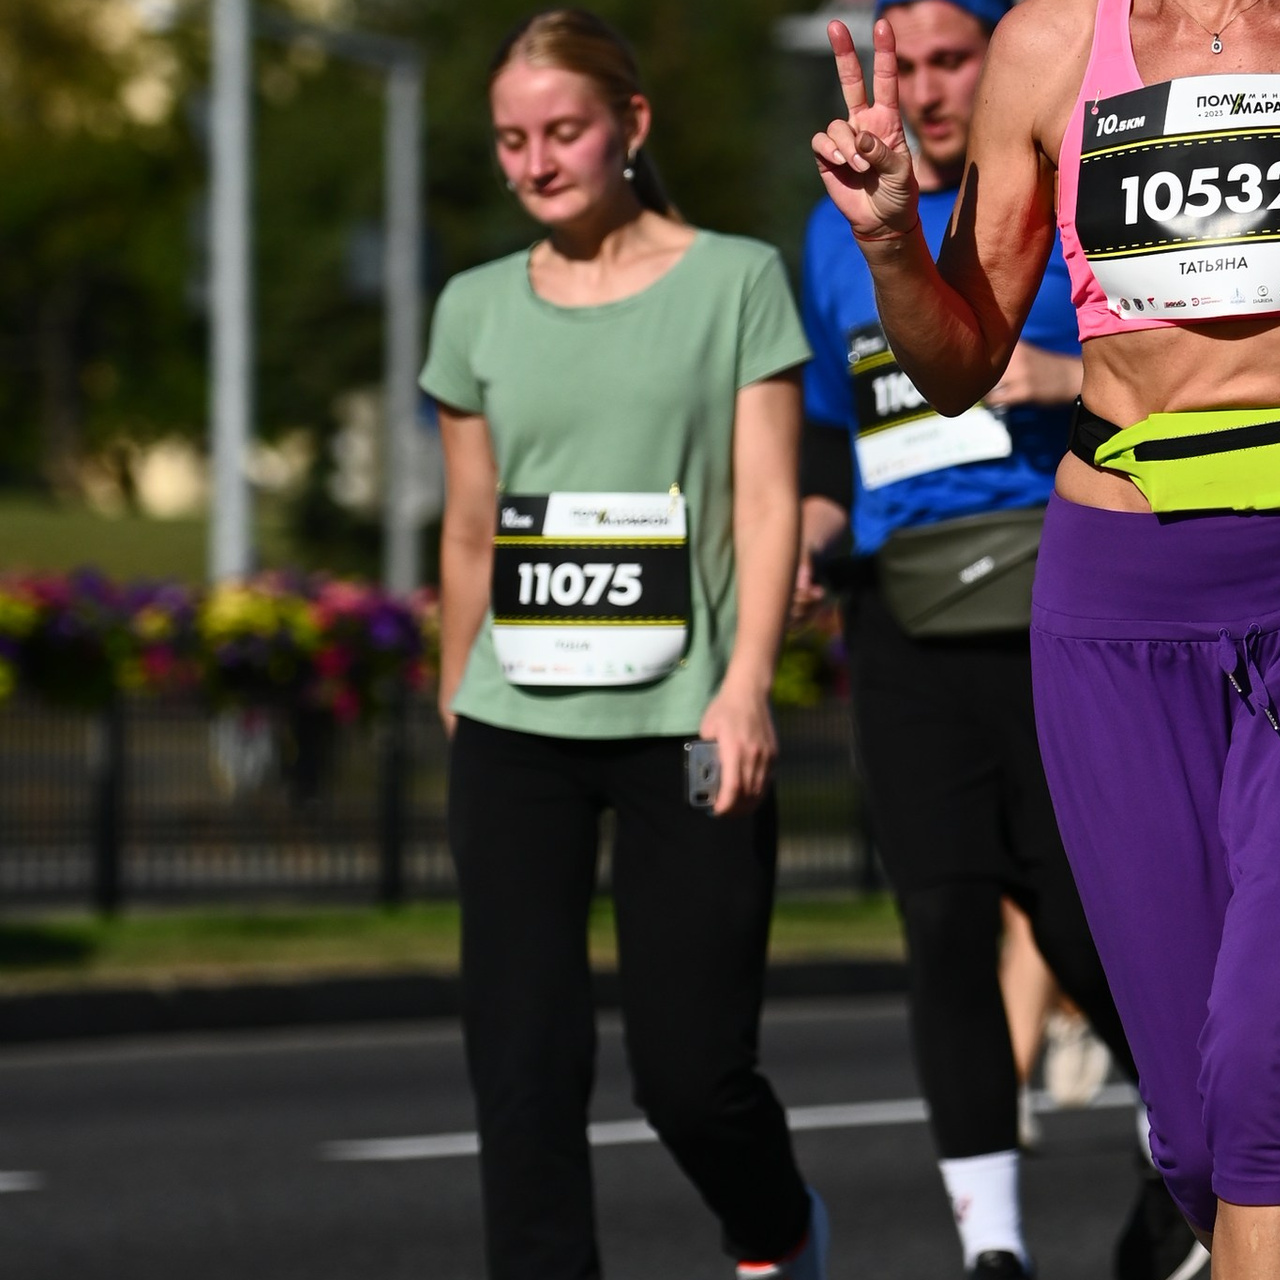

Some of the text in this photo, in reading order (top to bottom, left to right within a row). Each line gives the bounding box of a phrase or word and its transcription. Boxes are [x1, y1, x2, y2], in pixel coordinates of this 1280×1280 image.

[1204, 109, 1224, 118] 2023
[1179, 256, 1249, 275] ТАТЬЯНА
[517, 562, 643, 607] 11075
